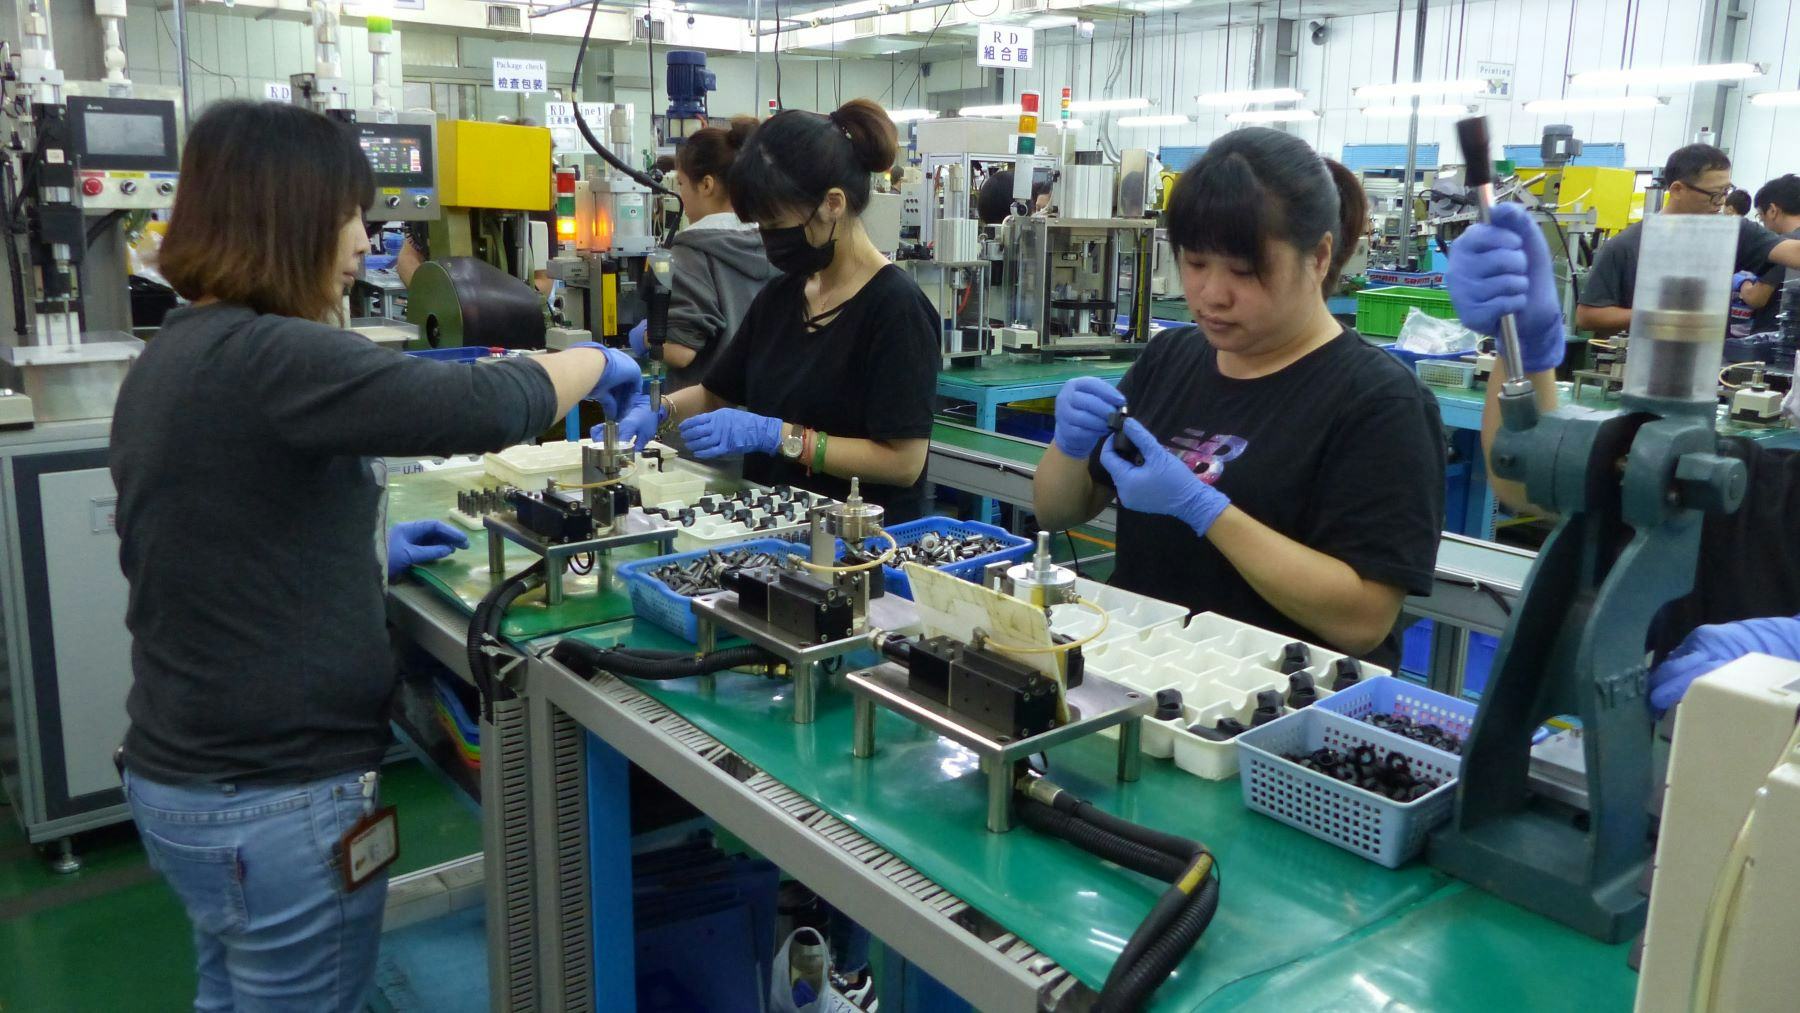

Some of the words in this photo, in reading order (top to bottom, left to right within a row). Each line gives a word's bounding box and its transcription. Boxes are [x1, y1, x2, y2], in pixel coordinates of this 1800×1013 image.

[983, 45, 1028, 62] 組合區
[496, 60, 523, 70] Package
[1480, 65, 1510, 76] Printing
